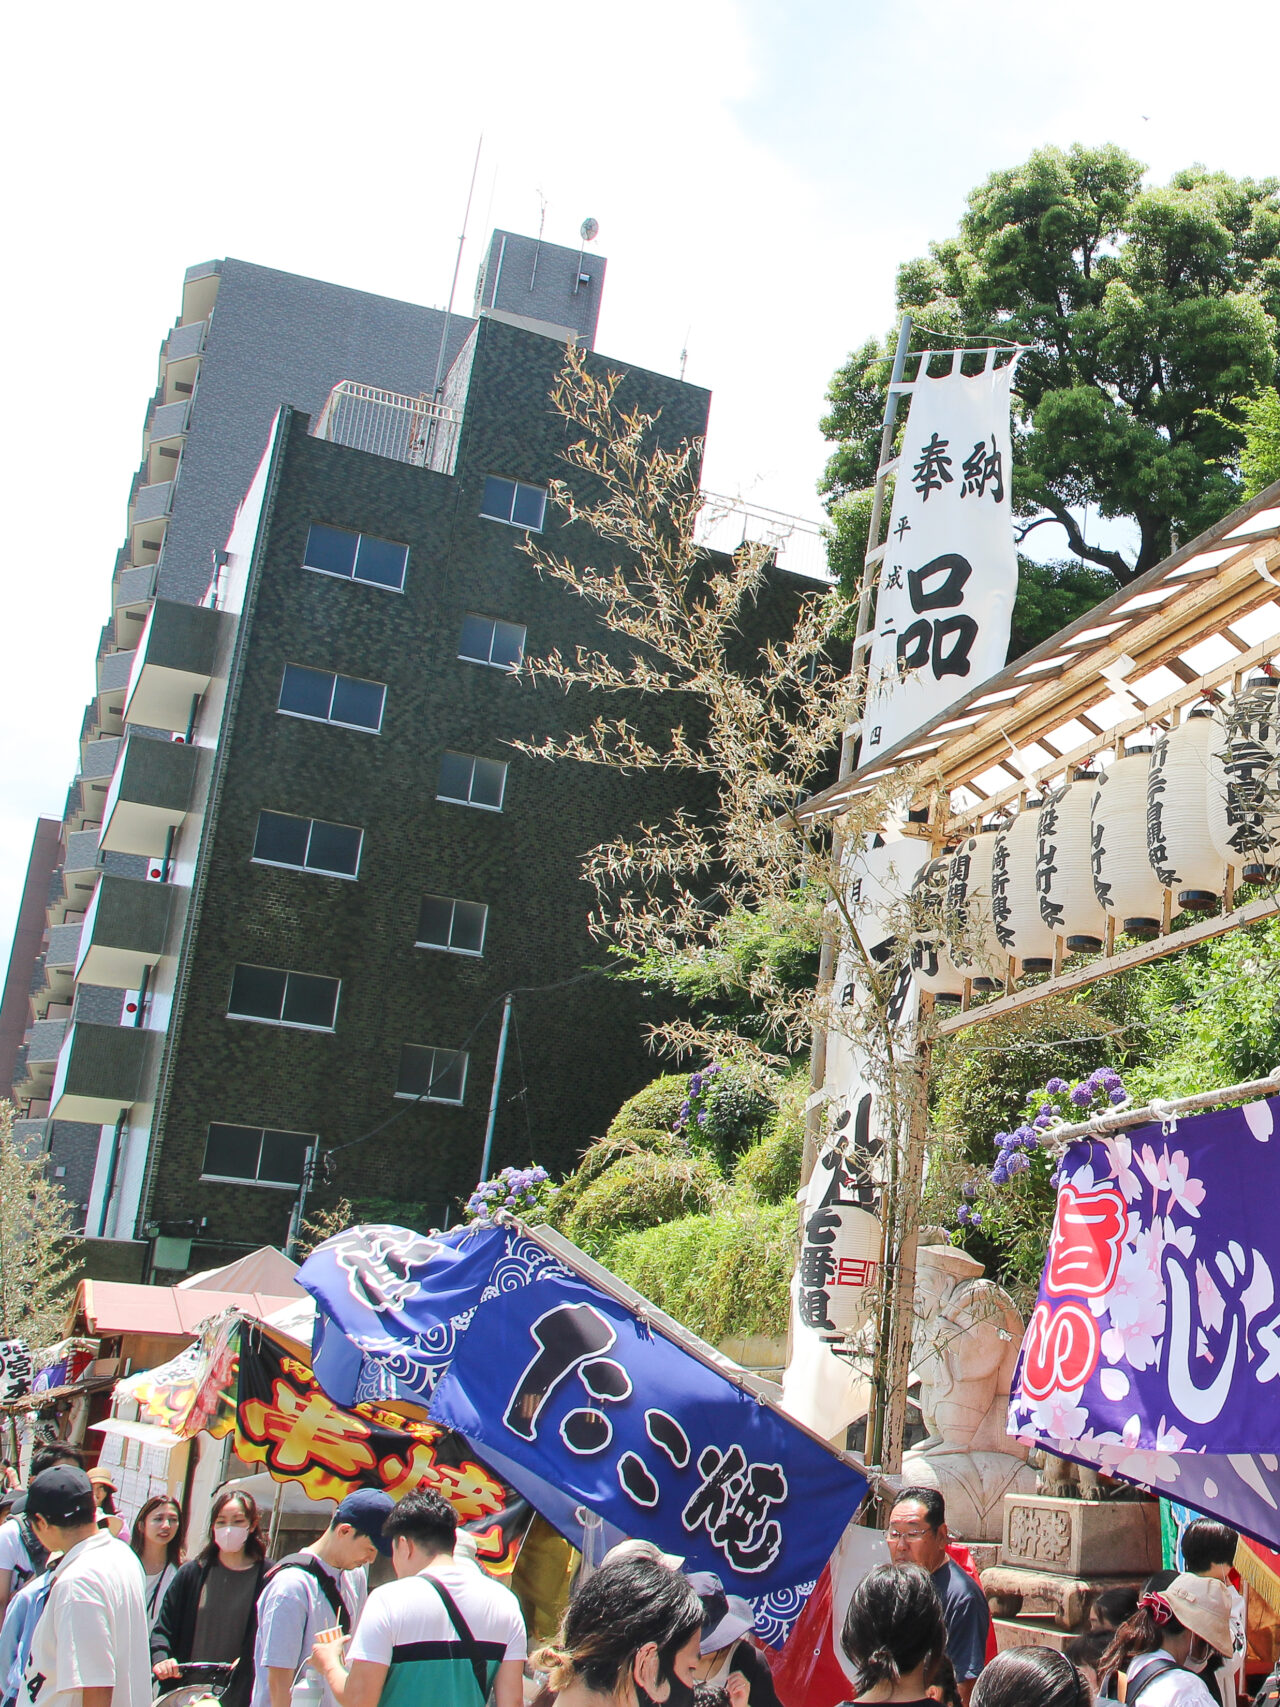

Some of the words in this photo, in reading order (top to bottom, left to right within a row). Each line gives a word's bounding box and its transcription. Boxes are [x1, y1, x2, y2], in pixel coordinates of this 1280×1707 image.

[911, 432, 1005, 504] 奉納
[897, 553, 979, 684] 品
[799, 1208, 843, 1331] 七番組
[1020, 1184, 1130, 1402] 旨い
[503, 1302, 790, 1574] たこ焼
